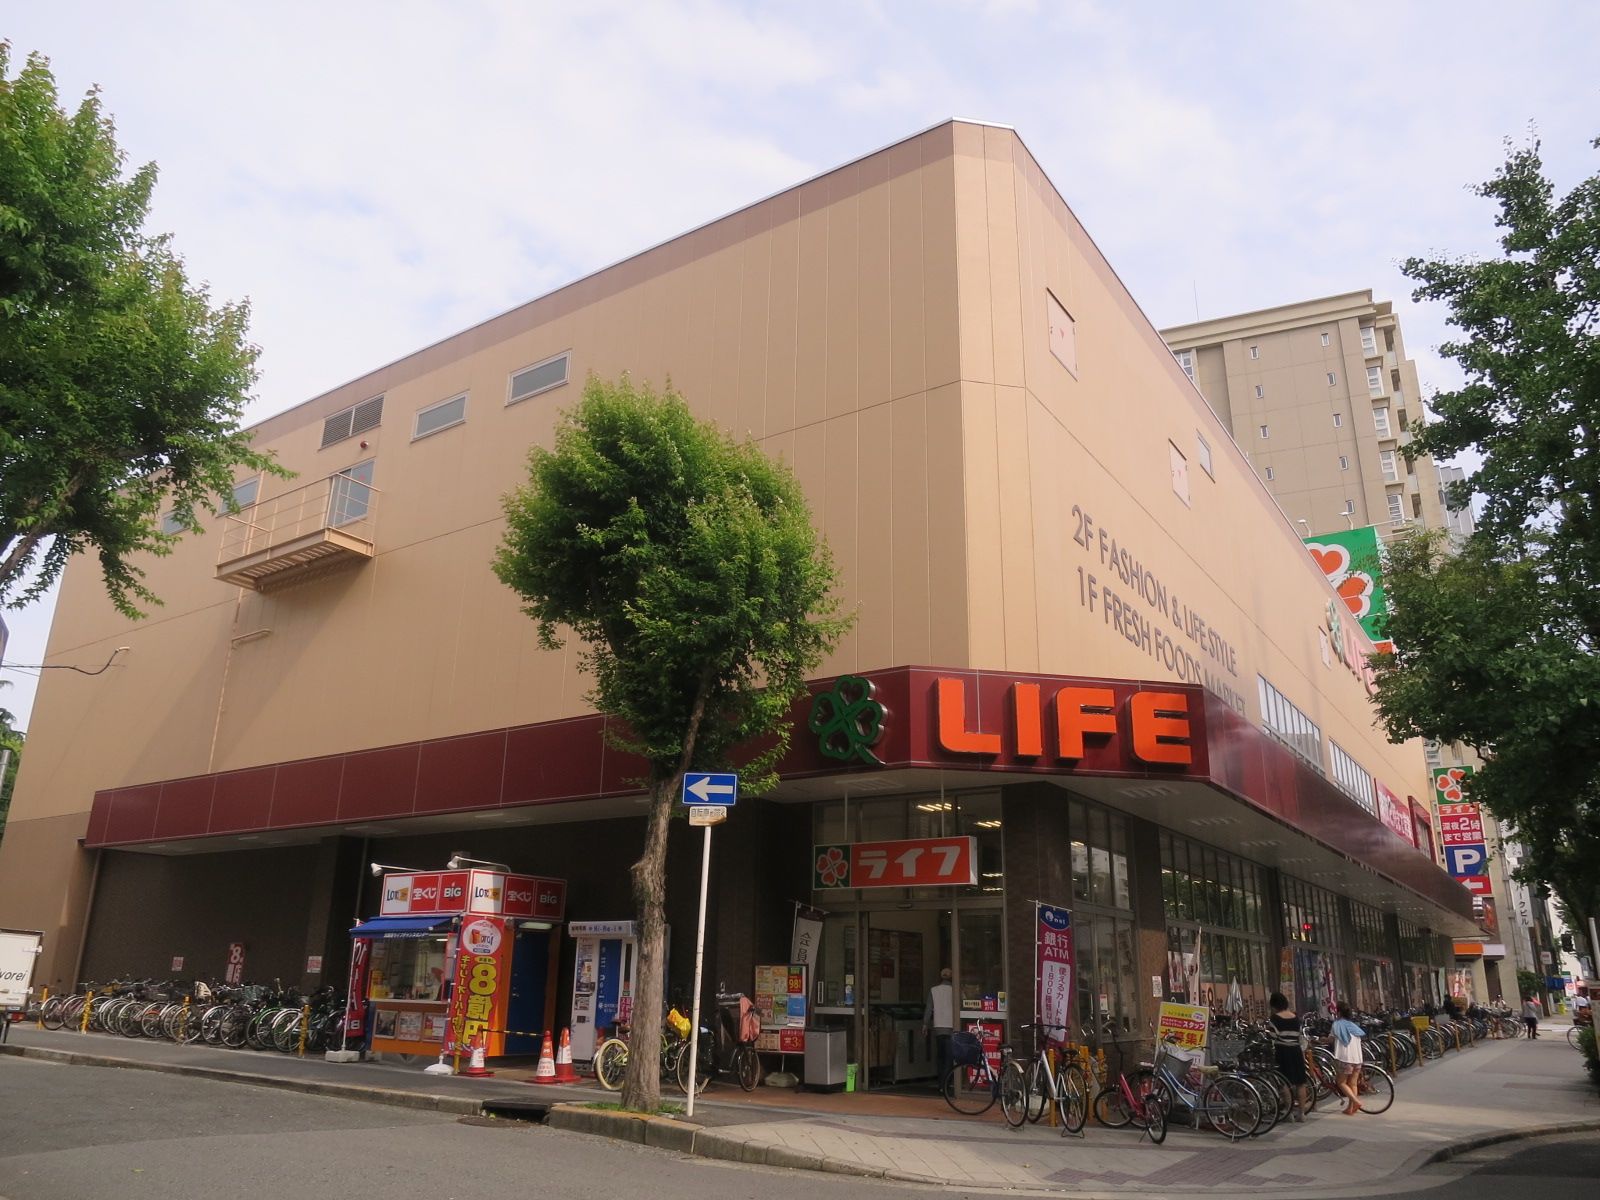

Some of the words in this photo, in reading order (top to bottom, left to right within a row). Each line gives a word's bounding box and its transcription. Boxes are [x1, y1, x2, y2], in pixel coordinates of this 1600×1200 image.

[1071, 504, 1094, 551] 2F
[1099, 527, 1169, 619] FASHION
[1171, 595, 1184, 631] &
[1077, 565, 1098, 613] 1F
[1103, 585, 1152, 657] FRESH
[1154, 626, 1202, 686] FOODS
[937, 676, 1192, 765] LIFE
[1442, 817, 1480, 831] 深夜2時
[1444, 831, 1482, 842] まで営業
[858, 846, 961, 879] ライフ
[1453, 848, 1481, 873] P
[413, 887, 437, 900] 宝くじ
[507, 890, 532, 903] 宝くじ
[1044, 931, 1069, 949] 銀行
[1043, 946, 1070, 960] ATM
[1182, 1020, 1205, 1031] スタッフ
